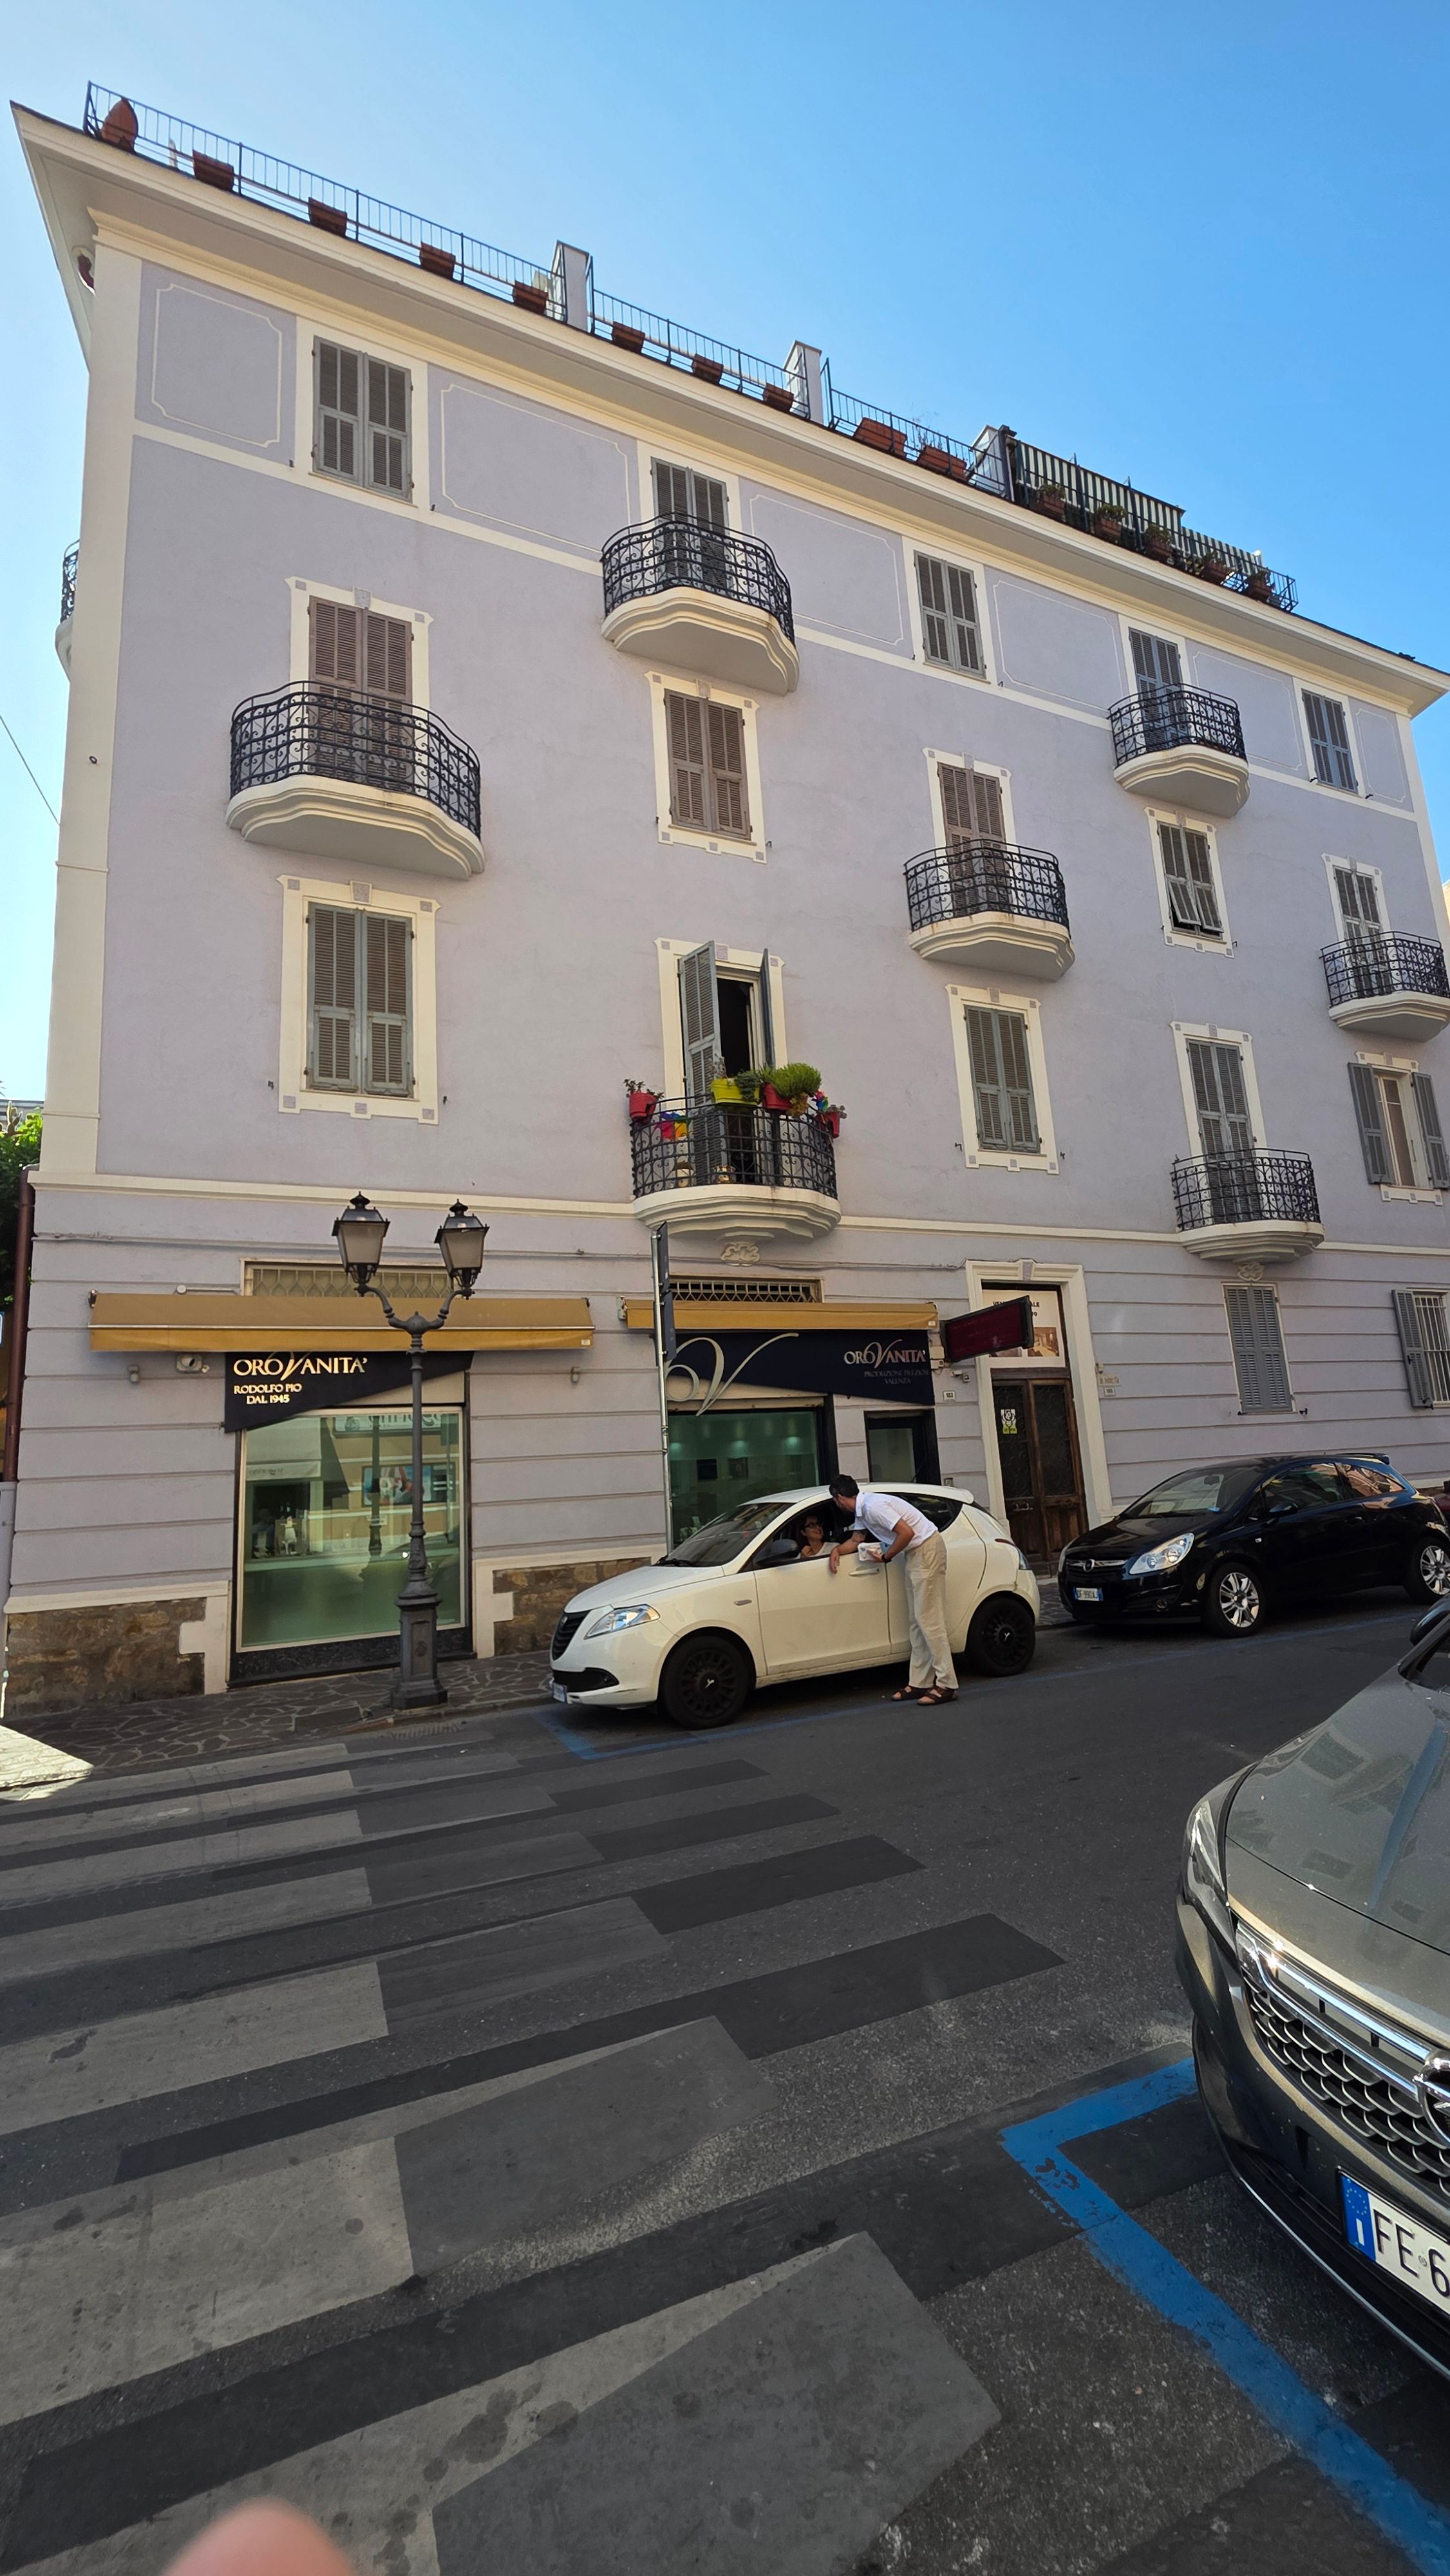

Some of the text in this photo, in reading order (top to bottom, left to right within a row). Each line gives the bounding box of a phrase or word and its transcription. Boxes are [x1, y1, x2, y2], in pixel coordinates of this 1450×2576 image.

[234, 1383, 303, 1394] RODOLFO PIO
[246, 1394, 290, 1405] DAL 1945
